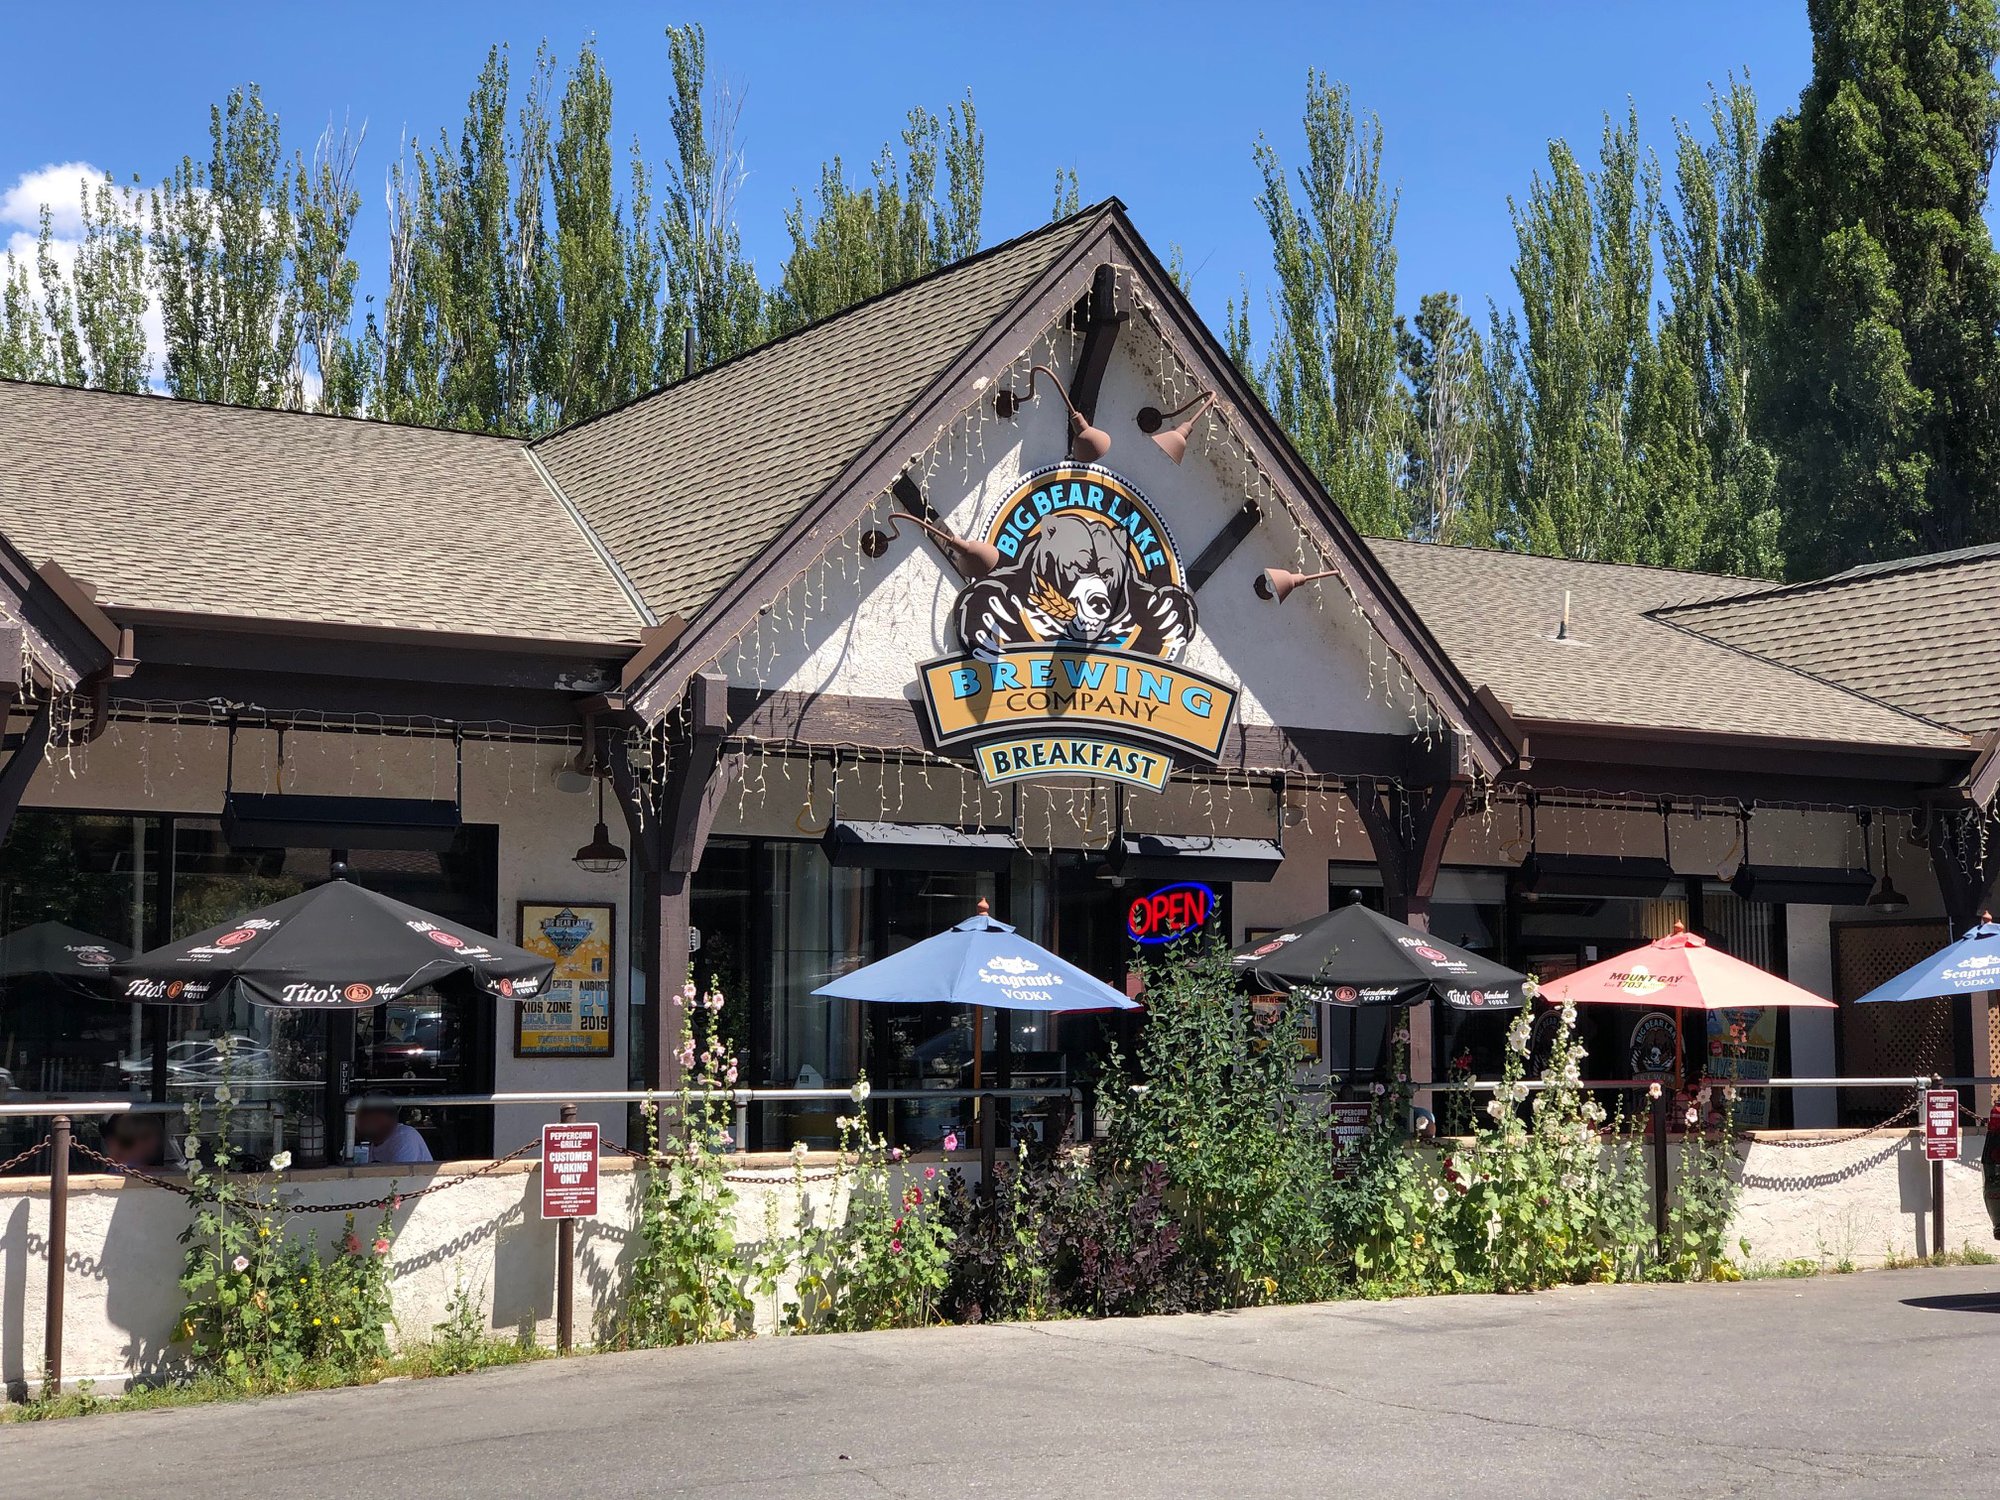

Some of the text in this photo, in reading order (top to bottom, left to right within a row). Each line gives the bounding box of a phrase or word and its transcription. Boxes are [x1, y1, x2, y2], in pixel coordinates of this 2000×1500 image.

[996, 482, 1166, 571] BIG BEAR LAKE
[949, 659, 1213, 719] BREWING
[1006, 690, 1160, 722] COMPANY
[993, 742, 1157, 780] BREAKFAST
[1128, 890, 1205, 936] OPEN
[978, 968, 1064, 989] Seagram's
[1609, 972, 1683, 983] MOUNT GAY
[1953, 978, 1994, 988] VODKA
[553, 980, 610, 991] ERIES AUGUST
[1001, 988, 1053, 1000] VODKA
[1358, 987, 1399, 996] Handmade
[1483, 989, 1509, 999] Handmade
[522, 1002, 572, 1014] KIDS ZONE
[579, 990, 609, 1016] 24
[581, 1016, 608, 1030] 2019
[550, 1132, 593, 1141] PEPPERCORN
[560, 1140, 582, 1149] GRILLE
[549, 1151, 593, 1162] CUSTOMER
[553, 1163, 589, 1174] PARKING
[560, 1174, 582, 1185] ONLY
